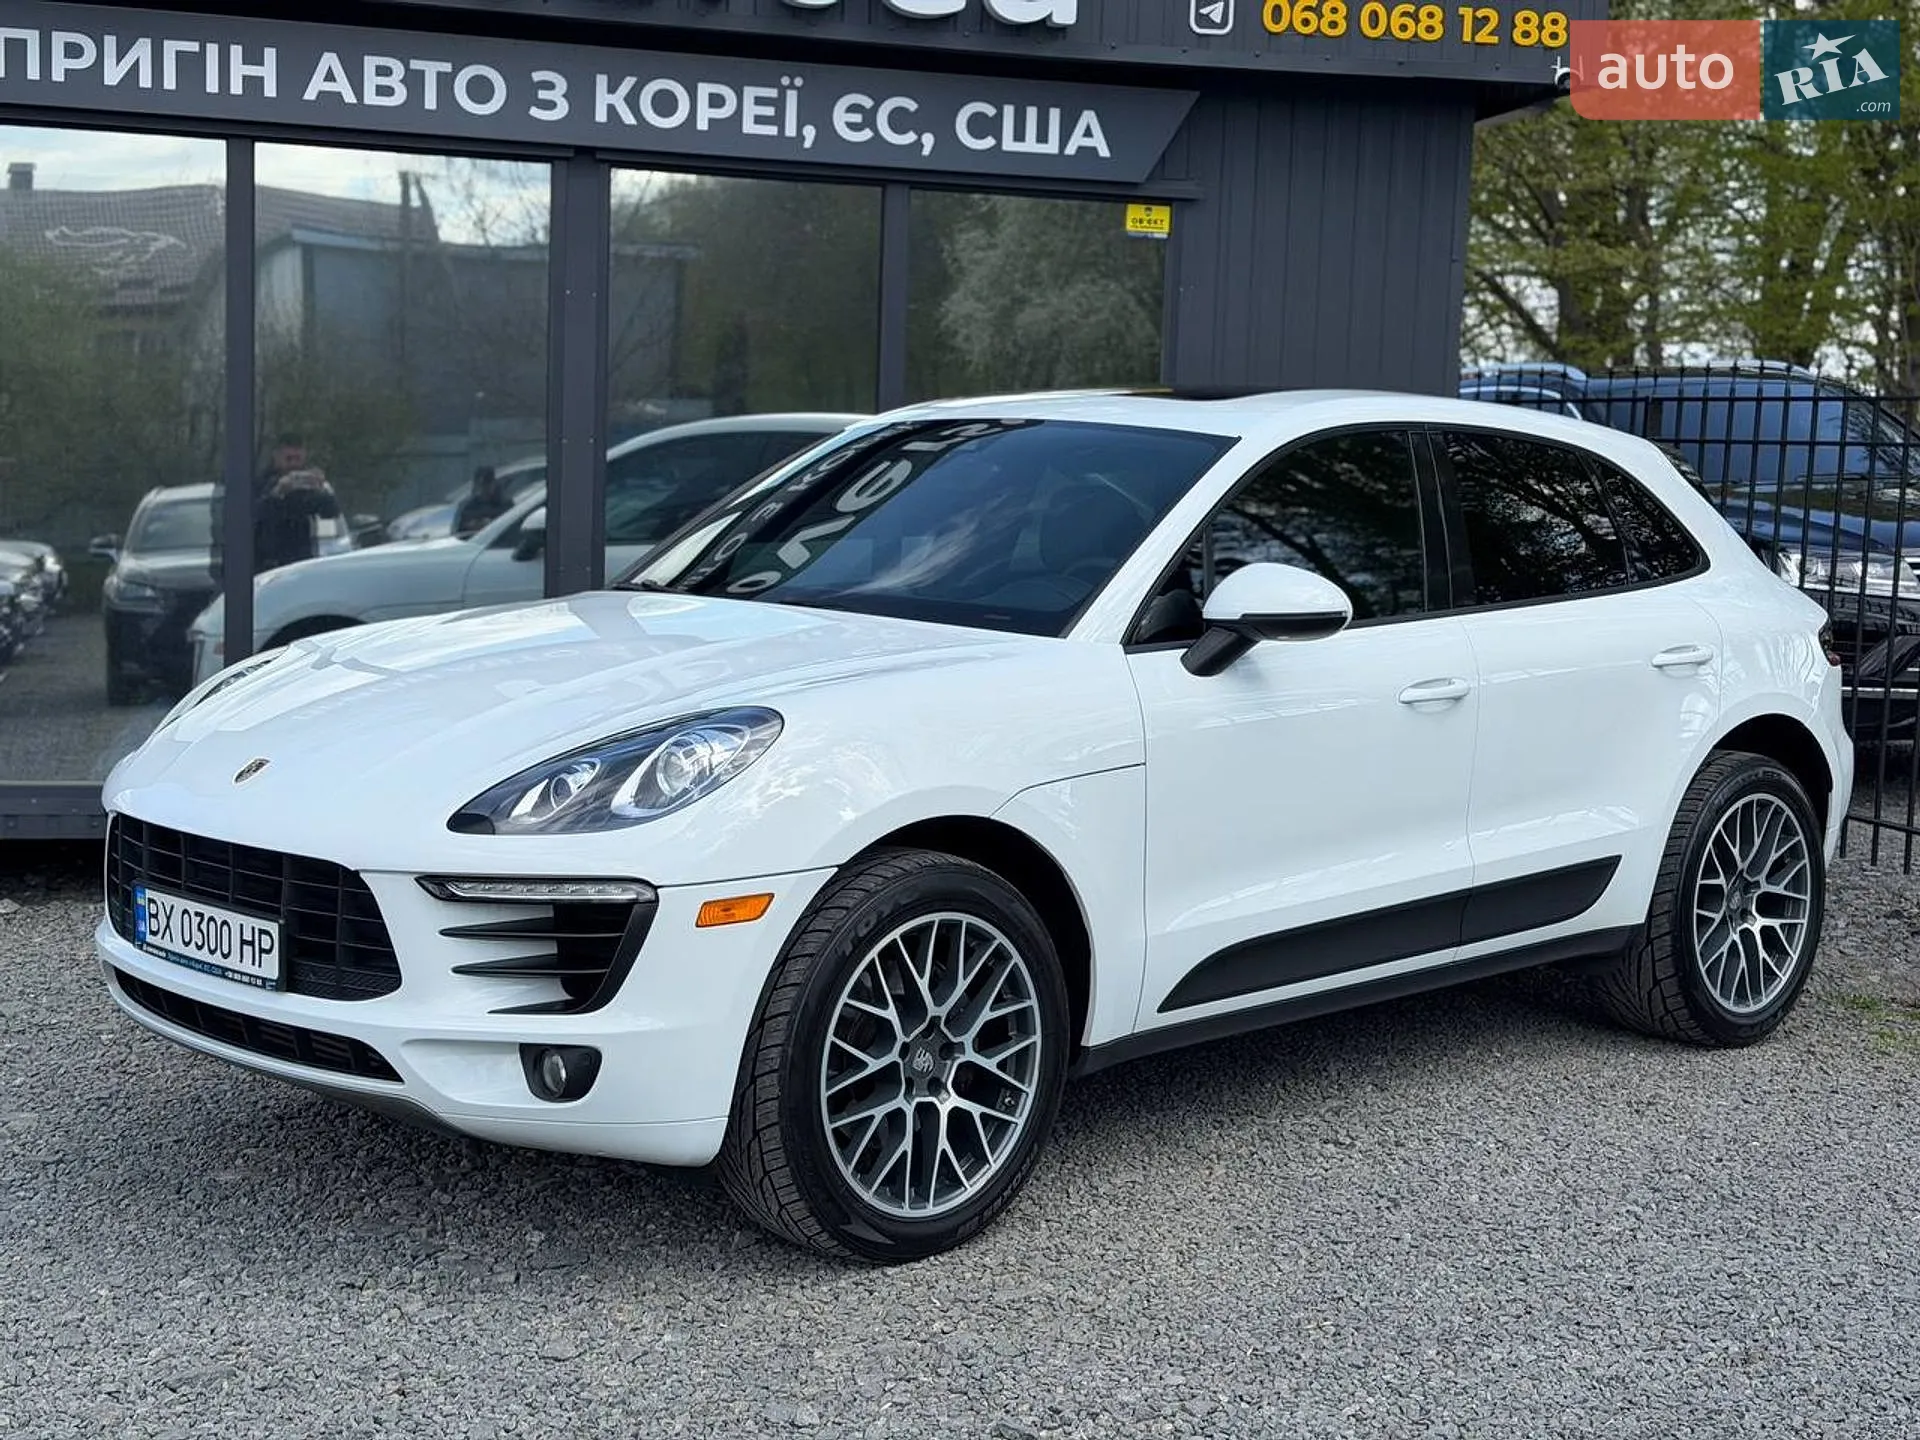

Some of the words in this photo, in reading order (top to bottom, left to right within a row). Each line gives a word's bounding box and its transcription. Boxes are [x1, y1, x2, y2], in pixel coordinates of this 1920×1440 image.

[1262, 0, 1347, 36] 068
[1360, 1, 1444, 41] 068
[1458, 7, 1499, 44] 12
[1512, 10, 1568, 48] 88
[0, 27, 278, 98] ПРИГІН
[301, 51, 508, 117] АВТО
[528, 70, 571, 122] З
[594, 73, 818, 149] КОРЕЇ,
[831, 93, 936, 157] ЄС,
[954, 101, 1112, 158] США
[148, 897, 175, 943] BX
[181, 908, 232, 960] 0300
[239, 923, 275, 968] HP
